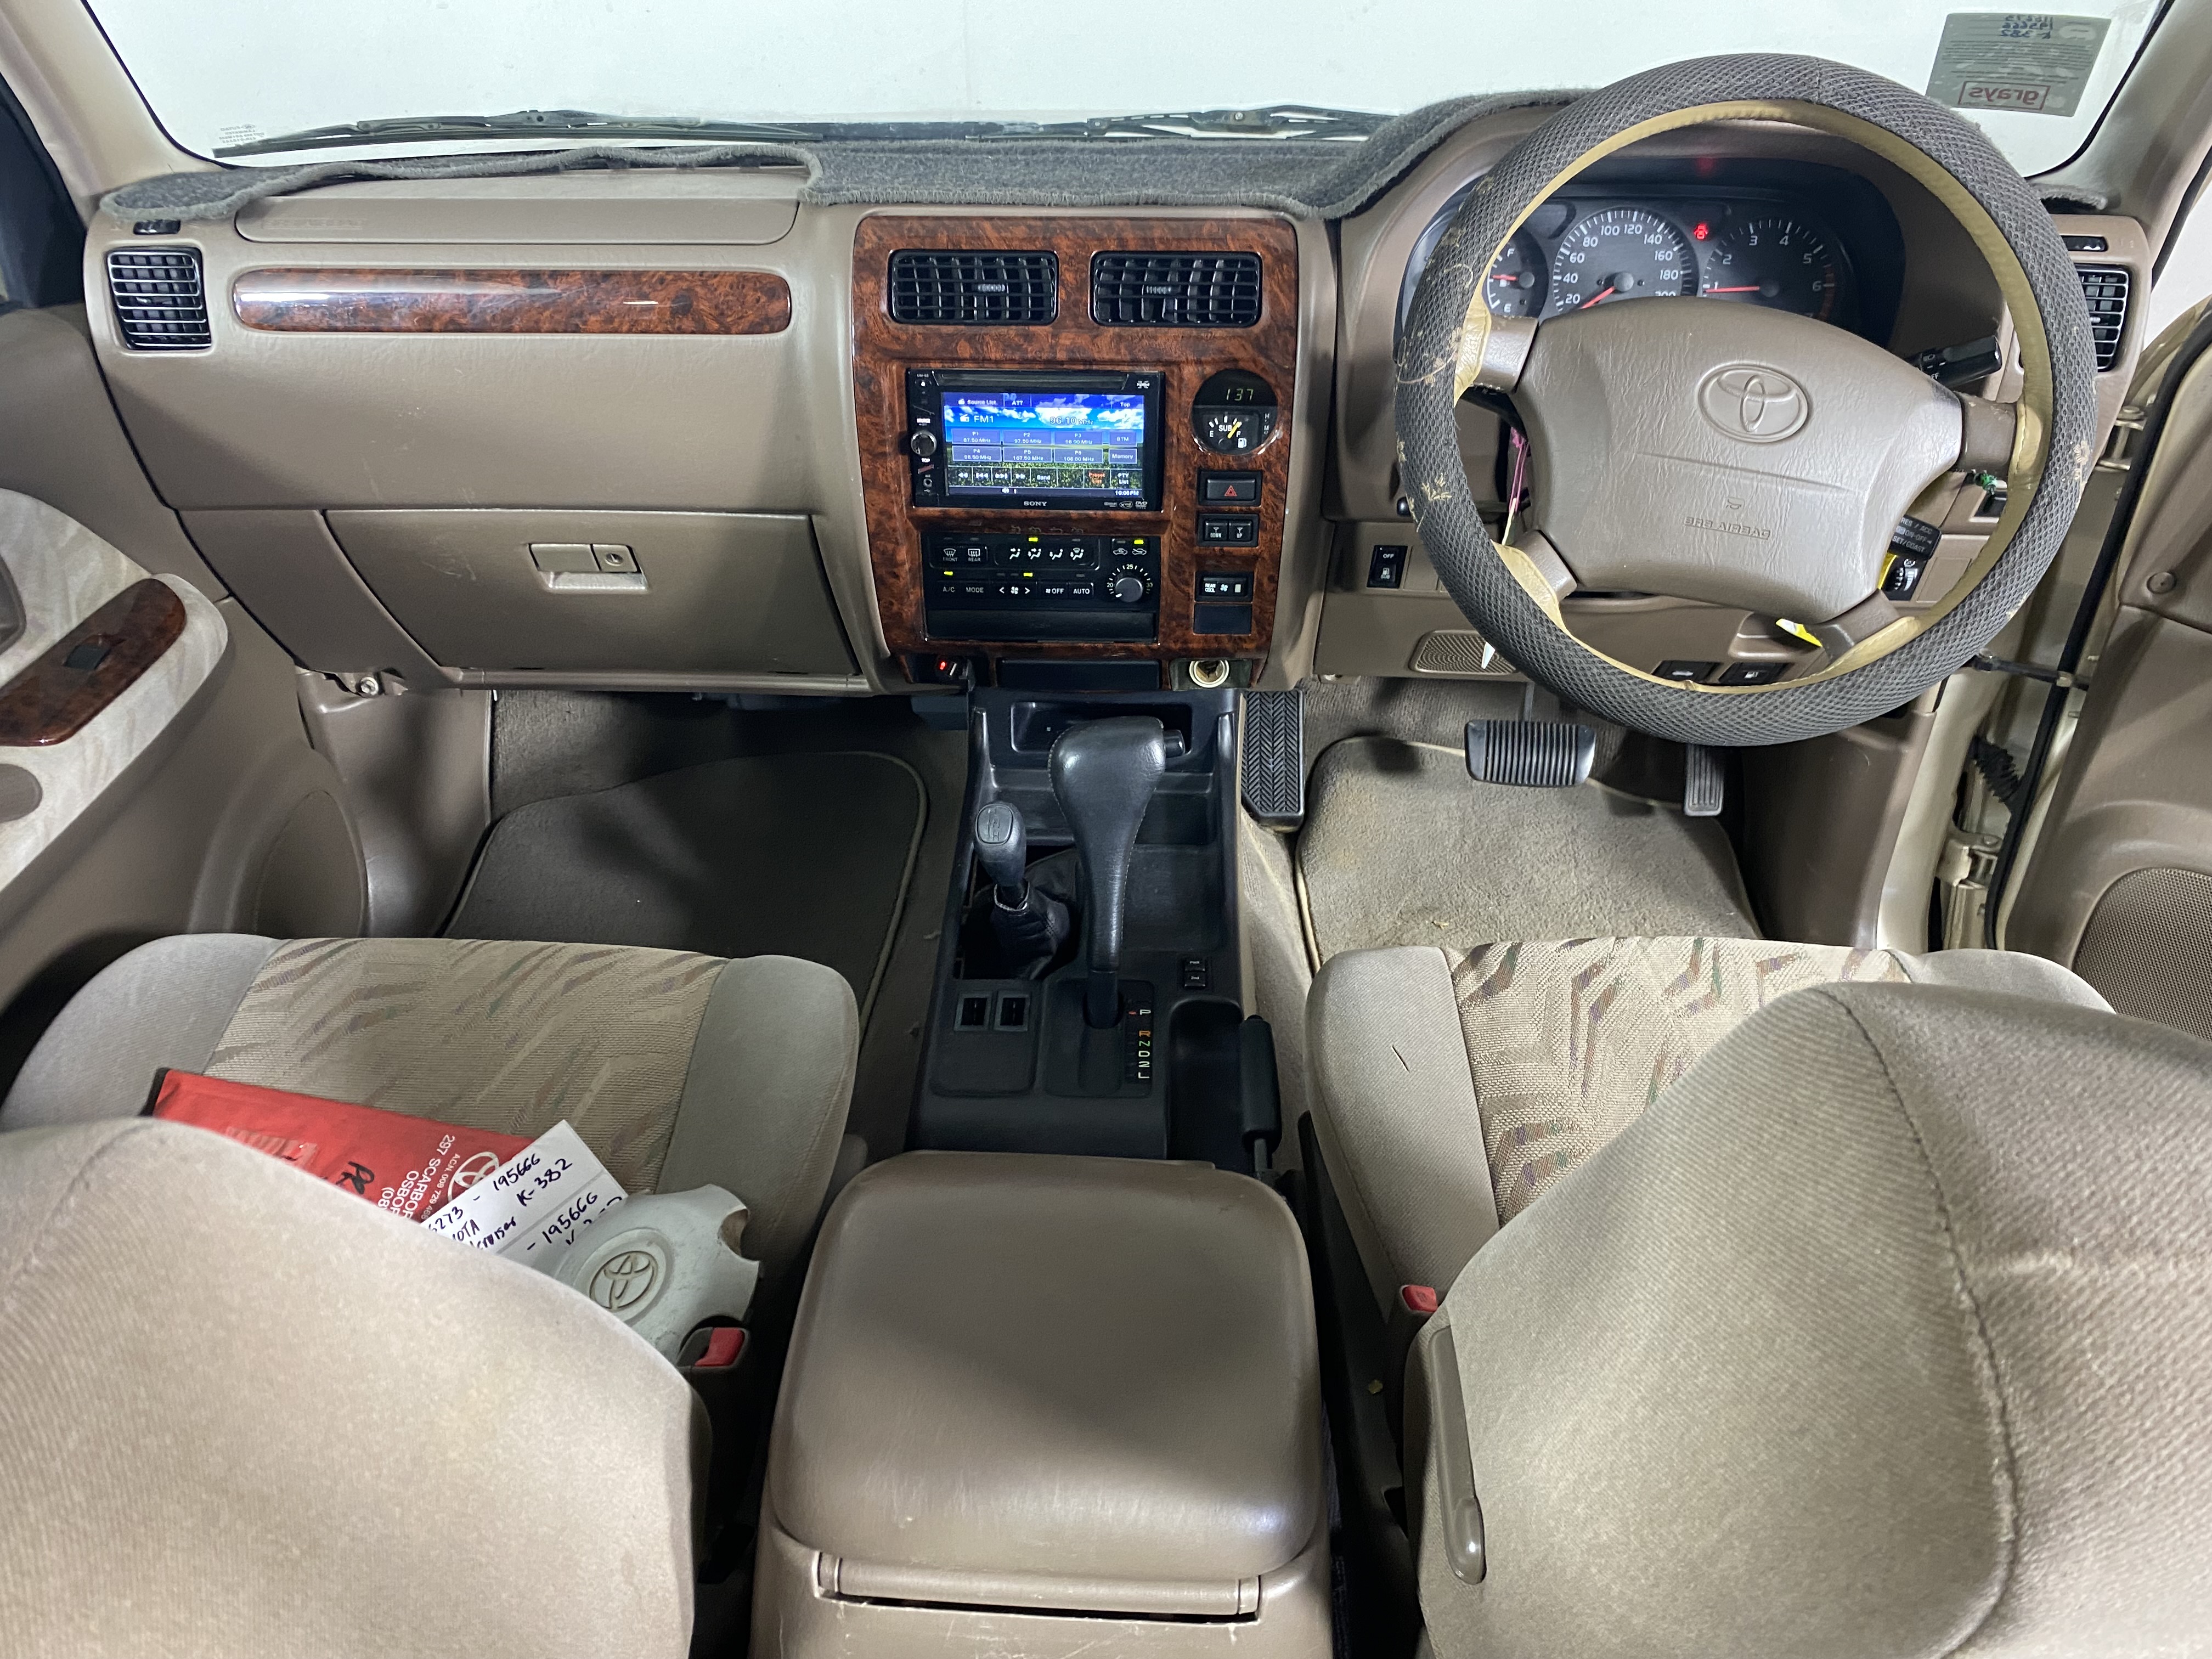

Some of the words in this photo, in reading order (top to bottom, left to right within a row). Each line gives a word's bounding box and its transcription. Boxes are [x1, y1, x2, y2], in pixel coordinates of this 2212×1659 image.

[1601, 225, 1620, 236] 100
[1624, 224, 1643, 234] 120
[1583, 236, 1598, 247] 80
[1644, 234, 1662, 245] 140
[1749, 235, 1758, 245] 3
[1779, 235, 1789, 245] 4
[1507, 248, 1515, 257] F
[1570, 252, 1585, 263] 60
[1655, 250, 1673, 261] 160
[1723, 254, 1732, 264] 2
[1803, 253, 1812, 263] 5
[1563, 273, 1578, 283] 40
[1660, 269, 1678, 280] 180
[1714, 281, 1718, 290] 1
[1812, 280, 1821, 291] 6
[1565, 294, 1580, 304] 20
[1504, 303, 1511, 313] E
[1050, 417, 1077, 425] 96.10
[1718, 522, 1771, 538] AIRBAG
[1900, 517, 1913, 526] RES
[1920, 525, 1933, 534] ACC
[436, 1134, 455, 1155] 297
[516, 1158, 573, 1206] K-382
